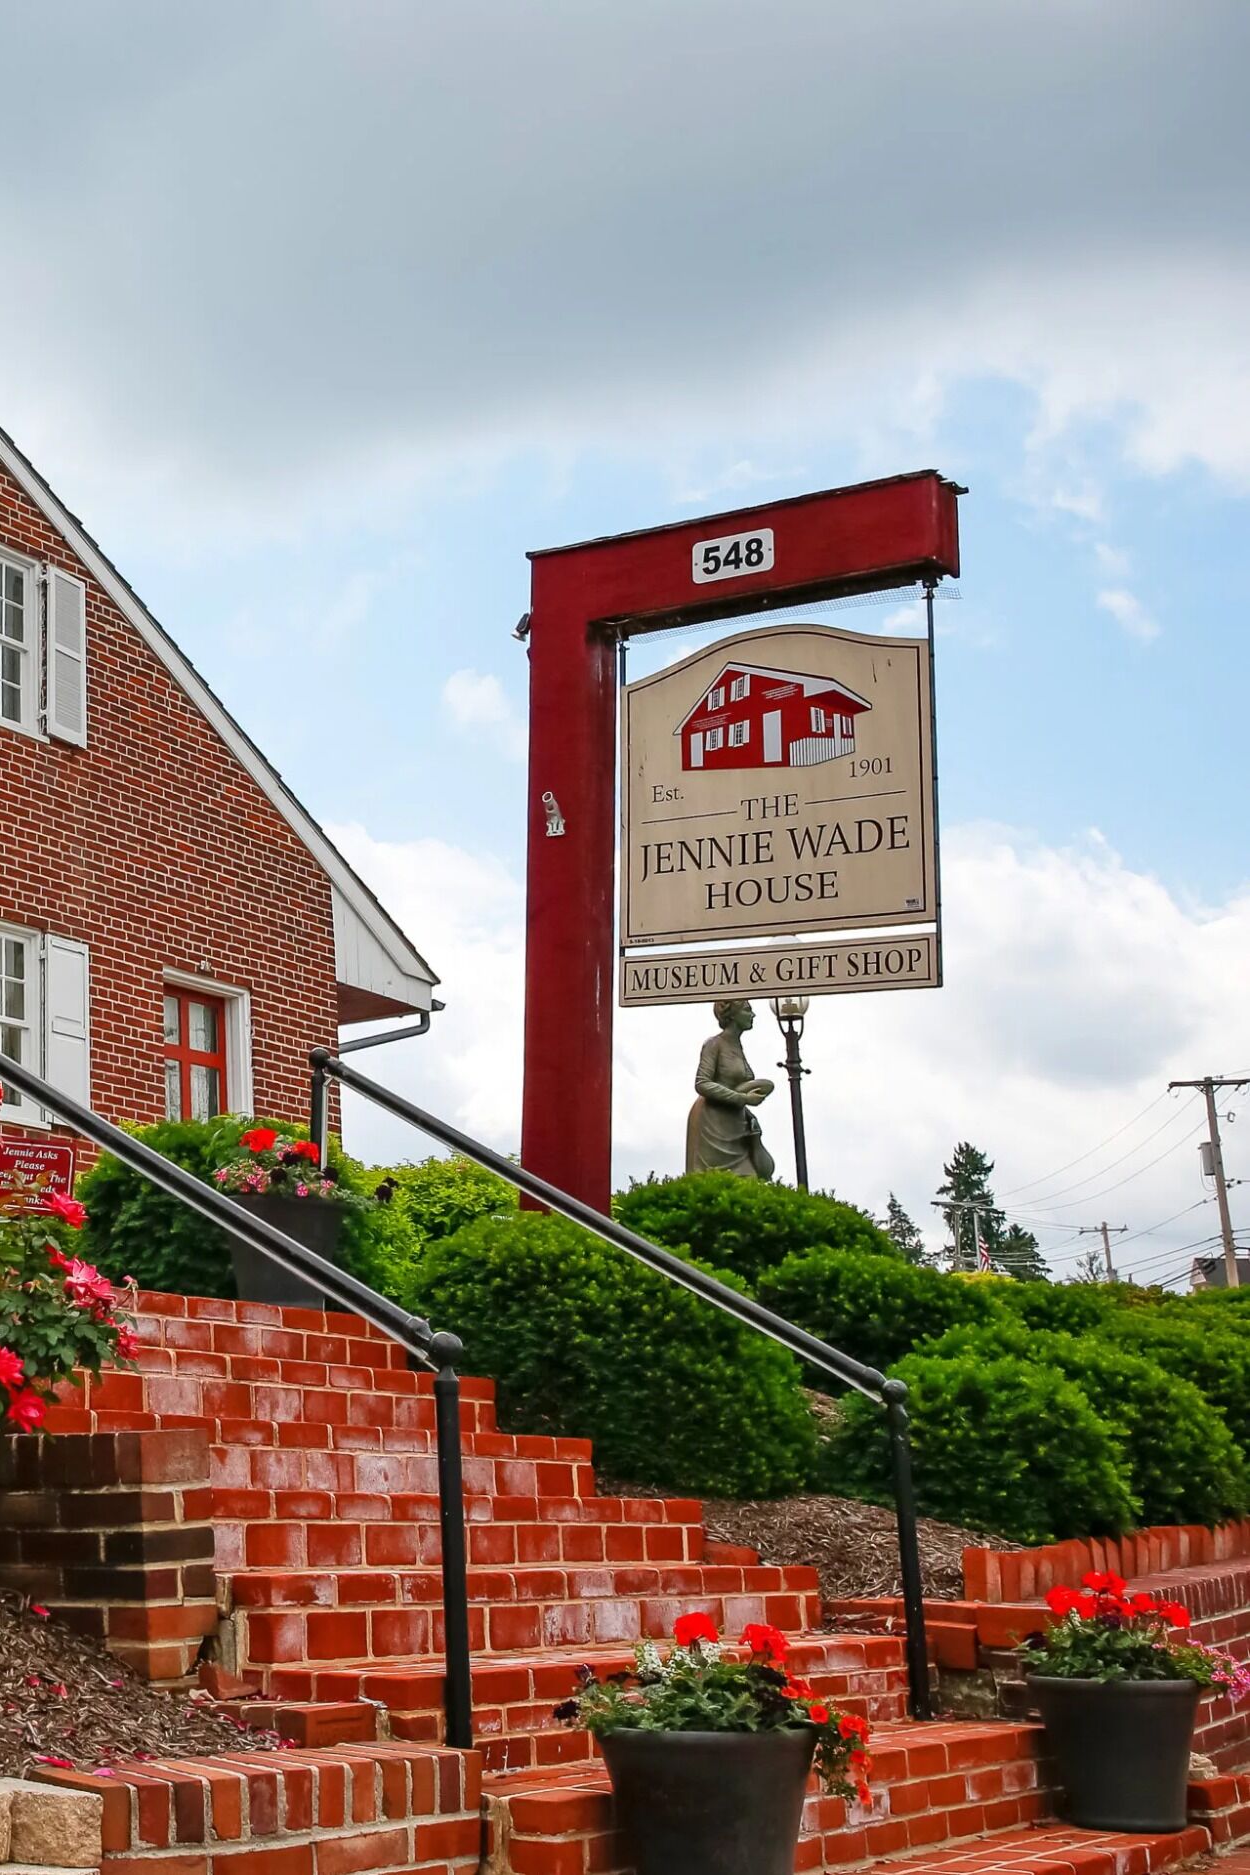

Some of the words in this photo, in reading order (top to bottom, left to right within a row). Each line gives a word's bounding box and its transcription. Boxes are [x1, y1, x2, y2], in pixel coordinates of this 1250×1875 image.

[702, 537, 764, 575] 548
[651, 785, 685, 803] Est.
[848, 757, 893, 778] 1901
[740, 793, 799, 821] THE
[640, 830, 774, 882] JENNIE
[786, 815, 910, 860] WADE
[704, 871, 839, 910] HOUSE
[630, 961, 740, 992] MUSEUM
[749, 962, 767, 983] &
[775, 953, 839, 982] GIFT
[846, 948, 922, 978] SHOP
[3, 1147, 35, 1158] Jennie
[35, 1150, 59, 1160] Asks
[13, 1159, 45, 1170] Please
